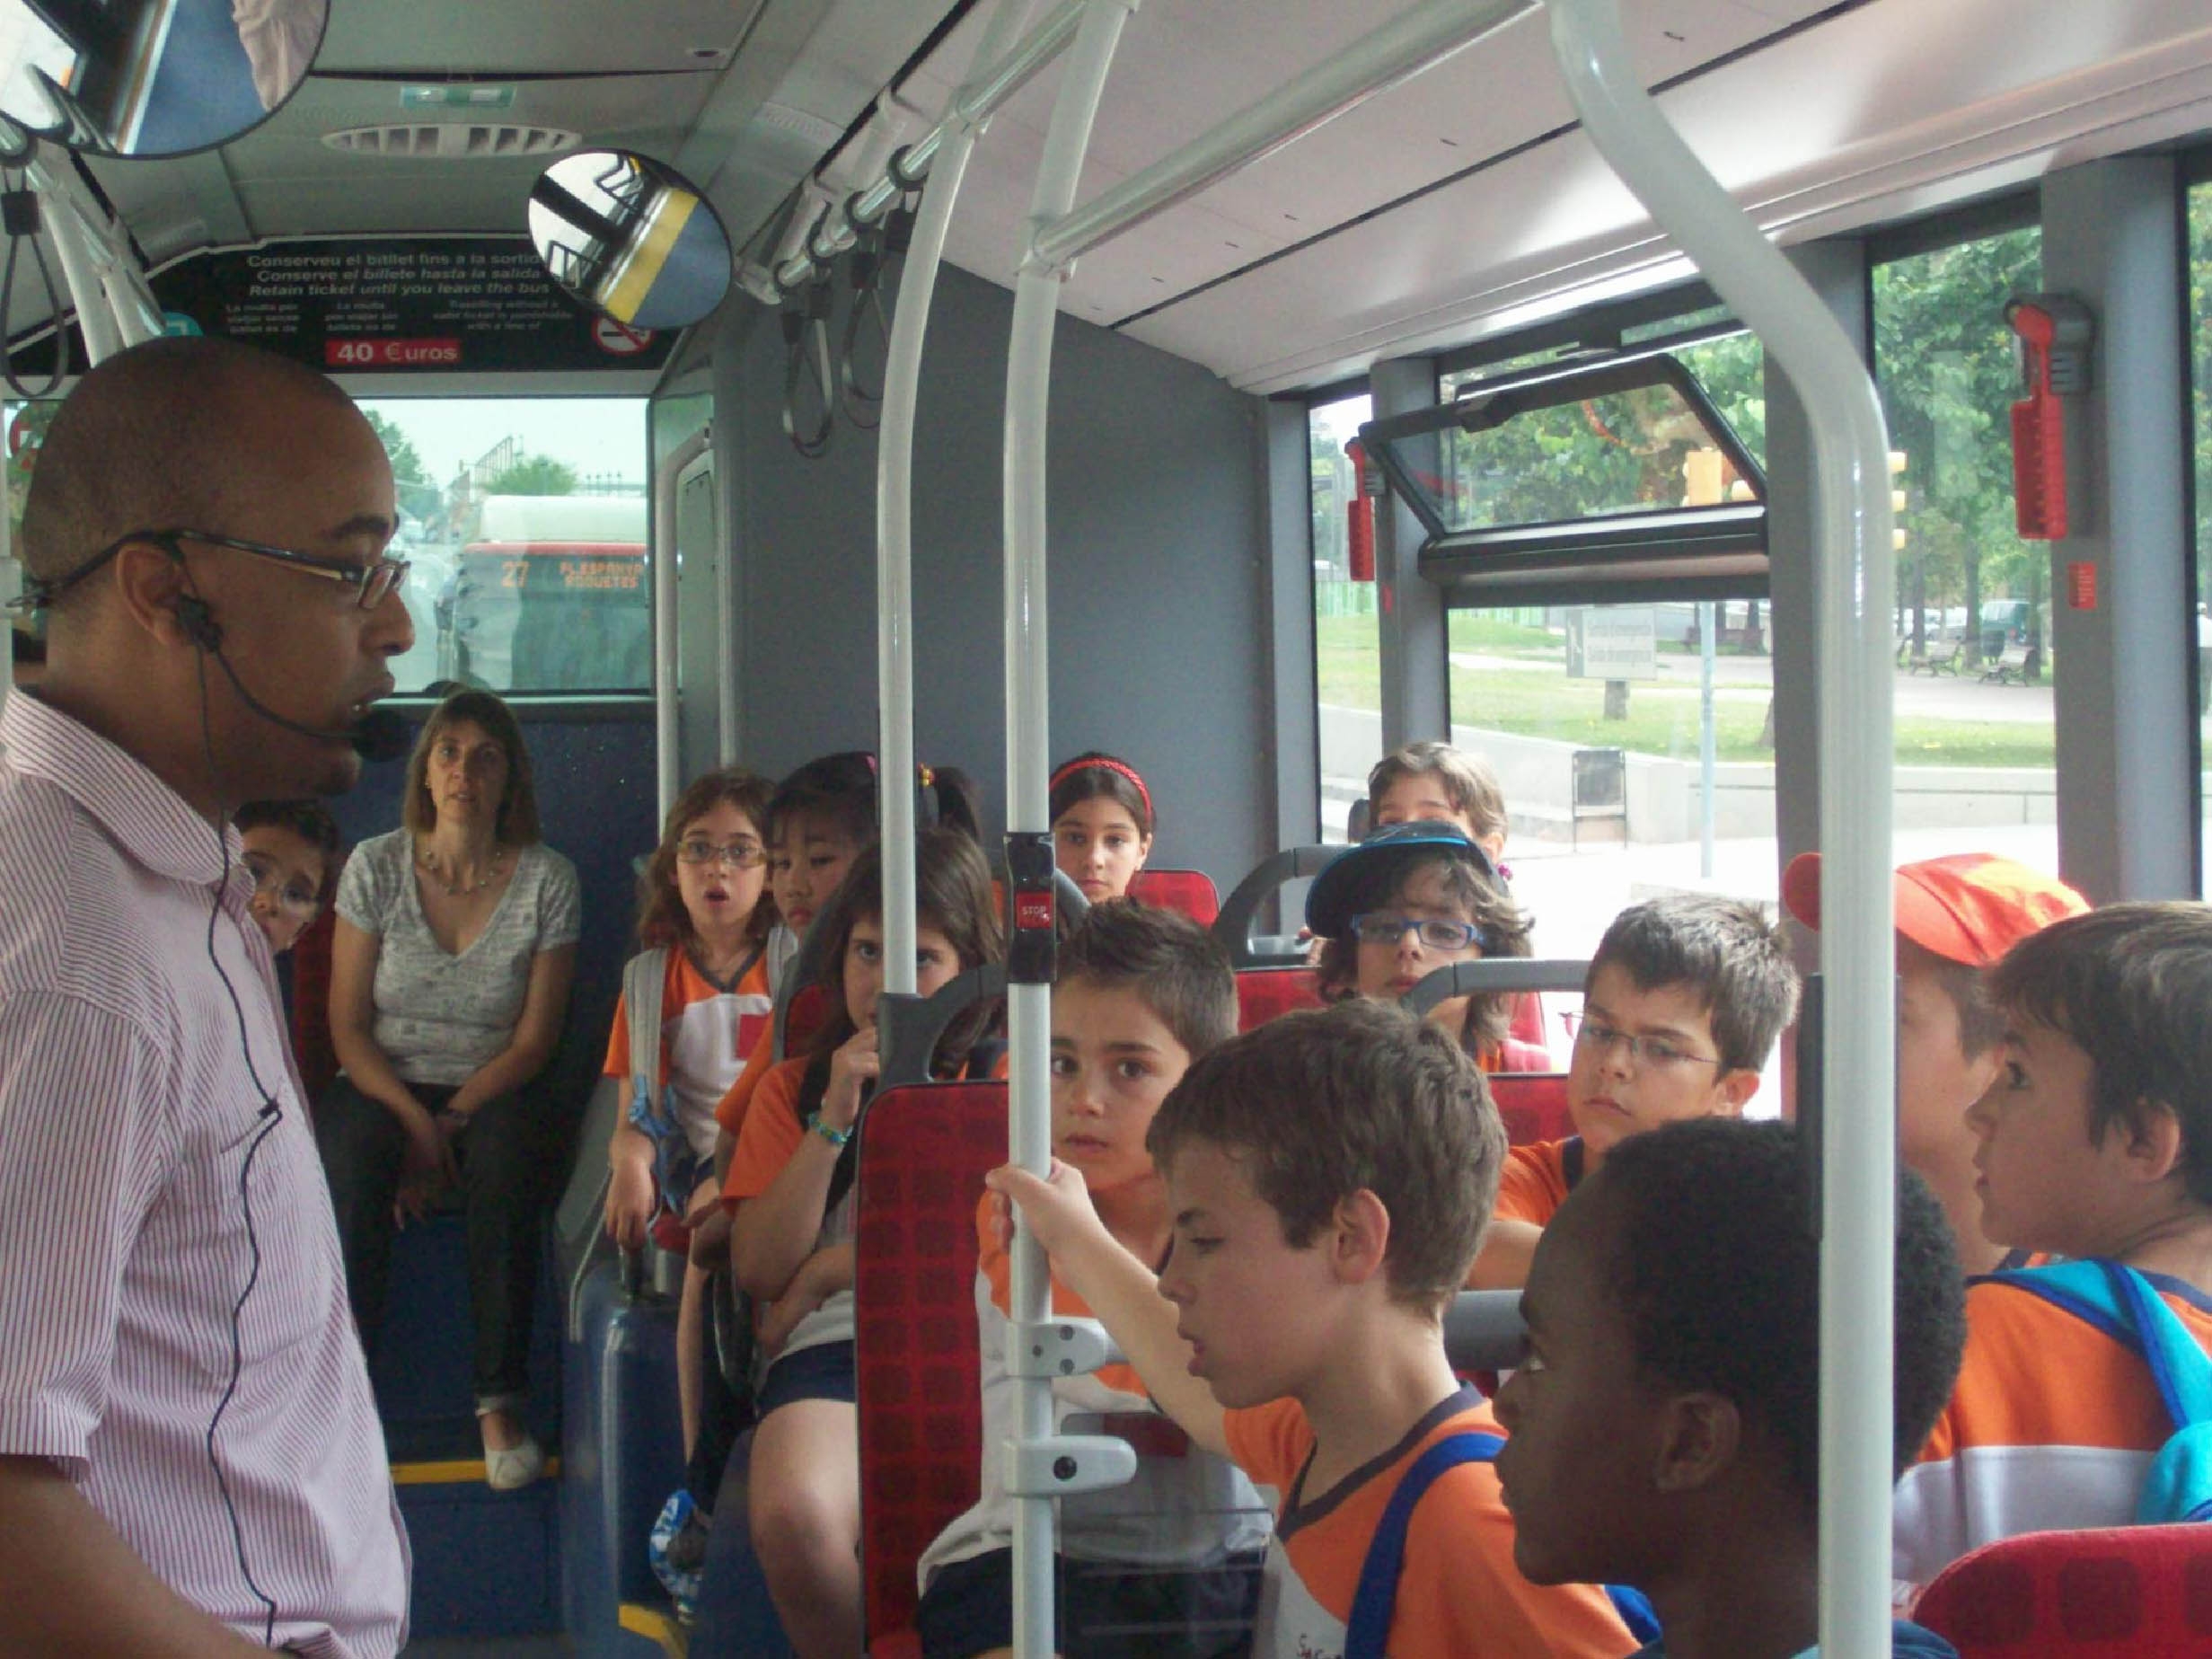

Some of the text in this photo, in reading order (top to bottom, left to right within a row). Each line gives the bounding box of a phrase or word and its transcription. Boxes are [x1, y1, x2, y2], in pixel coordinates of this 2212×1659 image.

[247, 255, 342, 268] Conserveu
[346, 254, 359, 267] el
[419, 254, 449, 265] fins
[455, 255, 465, 265] a
[471, 253, 486, 264] la
[257, 268, 541, 282] Conserve el billete hasta la salida
[250, 283, 551, 296] Retain ticket until you leave the bus
[338, 341, 374, 362] 40
[501, 560, 530, 588] 27
[1020, 905, 1047, 915] STOP
